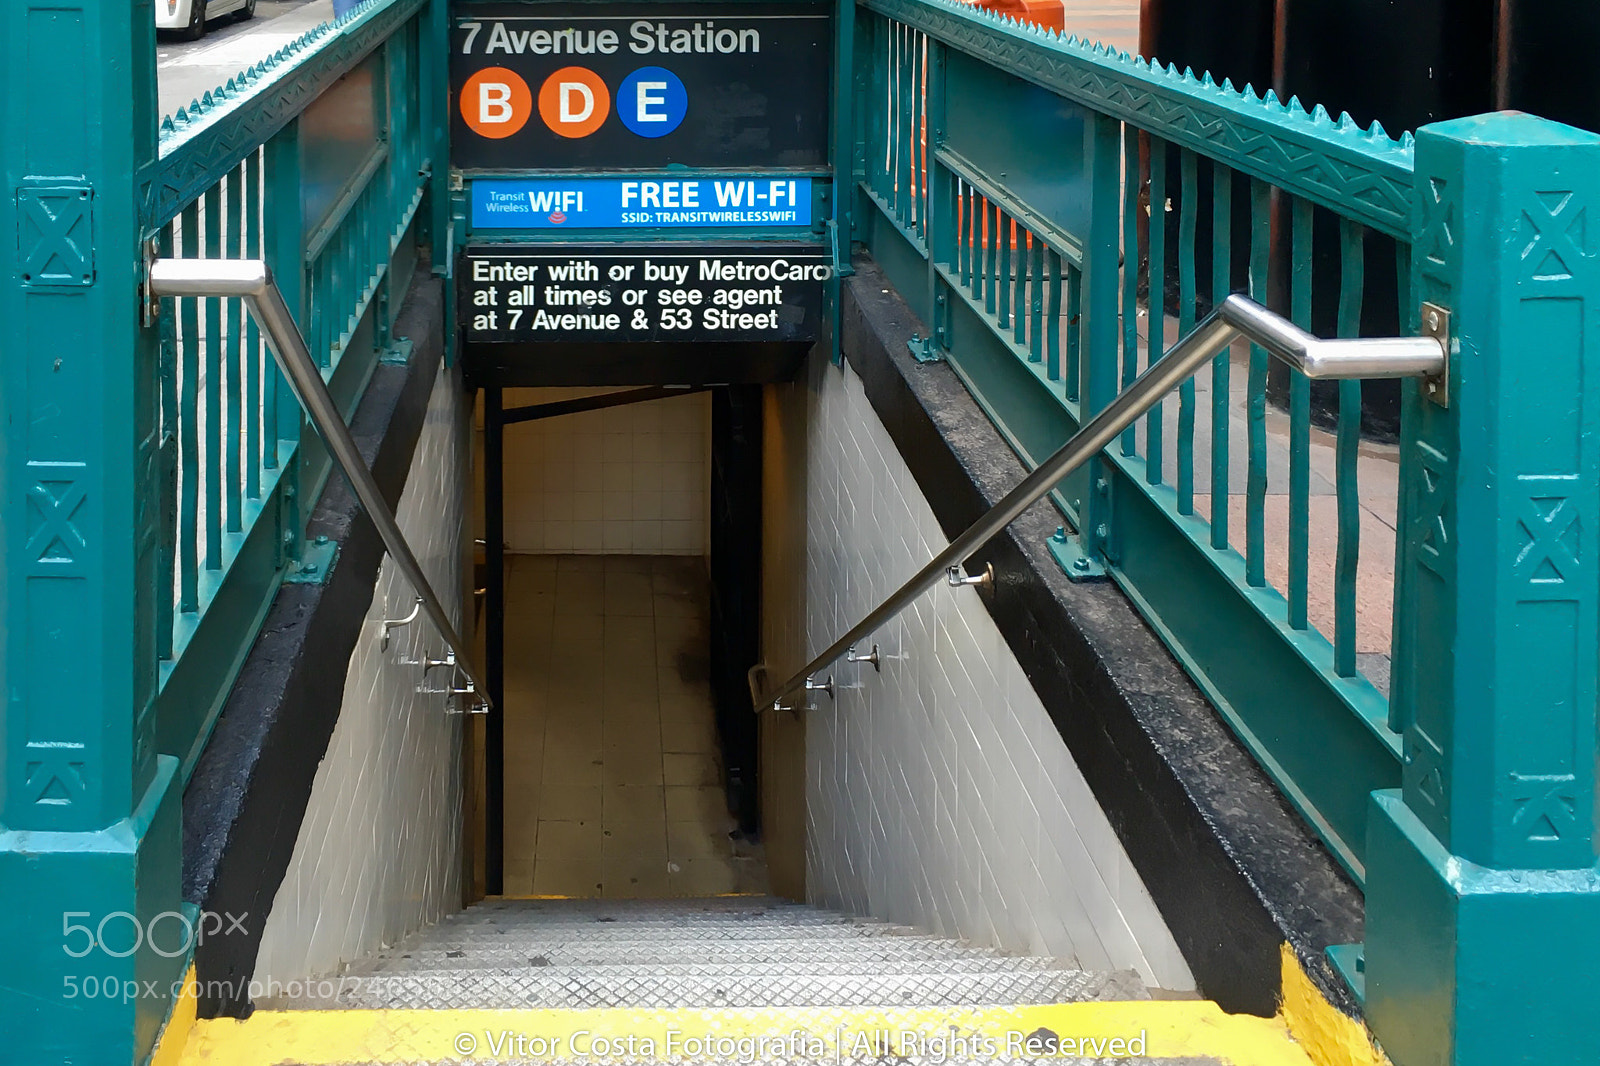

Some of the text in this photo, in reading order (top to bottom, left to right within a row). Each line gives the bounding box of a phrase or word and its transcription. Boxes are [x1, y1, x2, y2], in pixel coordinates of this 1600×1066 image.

[459, 20, 760, 54] 7 Avenue Station
[478, 81, 668, 124] B D E
[489, 191, 526, 202] Transit
[621, 180, 796, 208] FREE WI-FI
[485, 202, 529, 213] Wireless
[621, 211, 796, 224] SSID: TRANSITWIRELESSWIFI
[473, 260, 539, 282] Enter
[548, 260, 599, 282] with
[608, 265, 635, 282] or
[644, 260, 690, 285] buy
[473, 285, 783, 310] at all times or see agent
[473, 308, 779, 331] at 7 Avenue & 53 Street
